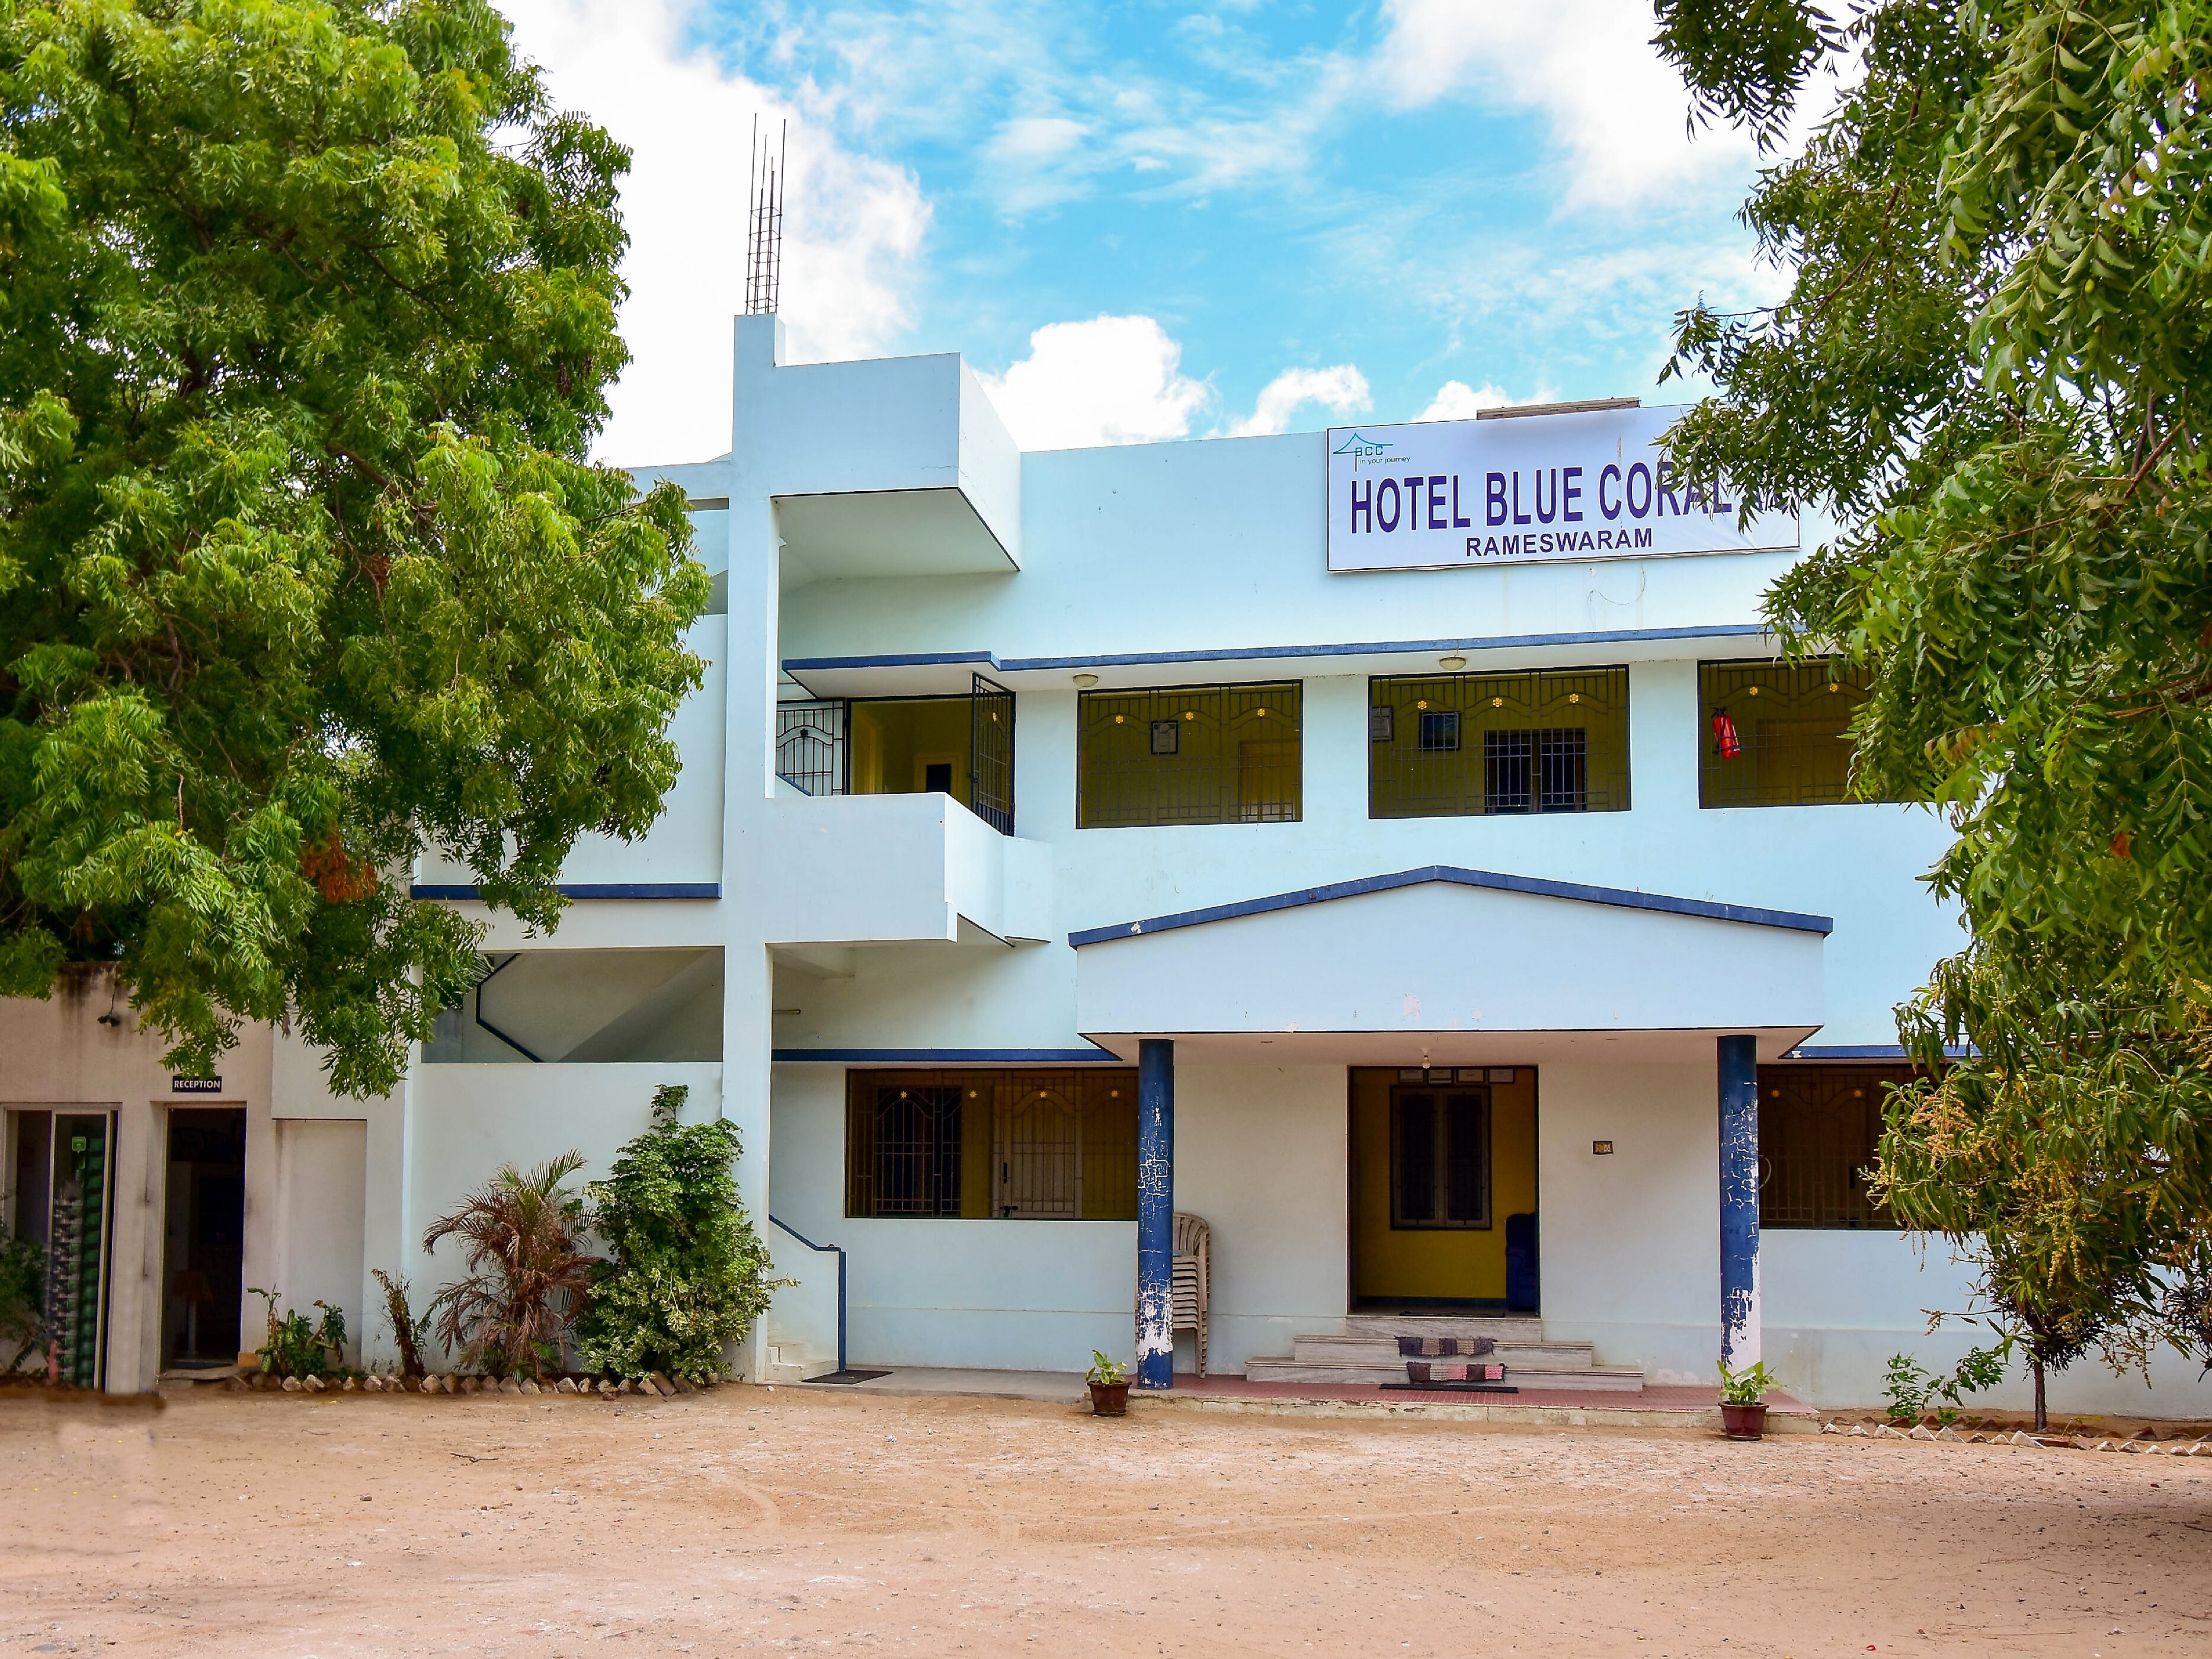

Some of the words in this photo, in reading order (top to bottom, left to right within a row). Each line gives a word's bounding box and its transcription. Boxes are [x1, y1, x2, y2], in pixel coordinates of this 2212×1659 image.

[1355, 446, 1384, 457] BCC
[1352, 475, 1471, 534] HOTEL
[1486, 467, 1583, 526] BLUE
[1467, 528, 1652, 556] RAMESWARAM
[174, 1080, 220, 1088] RECEPTION
